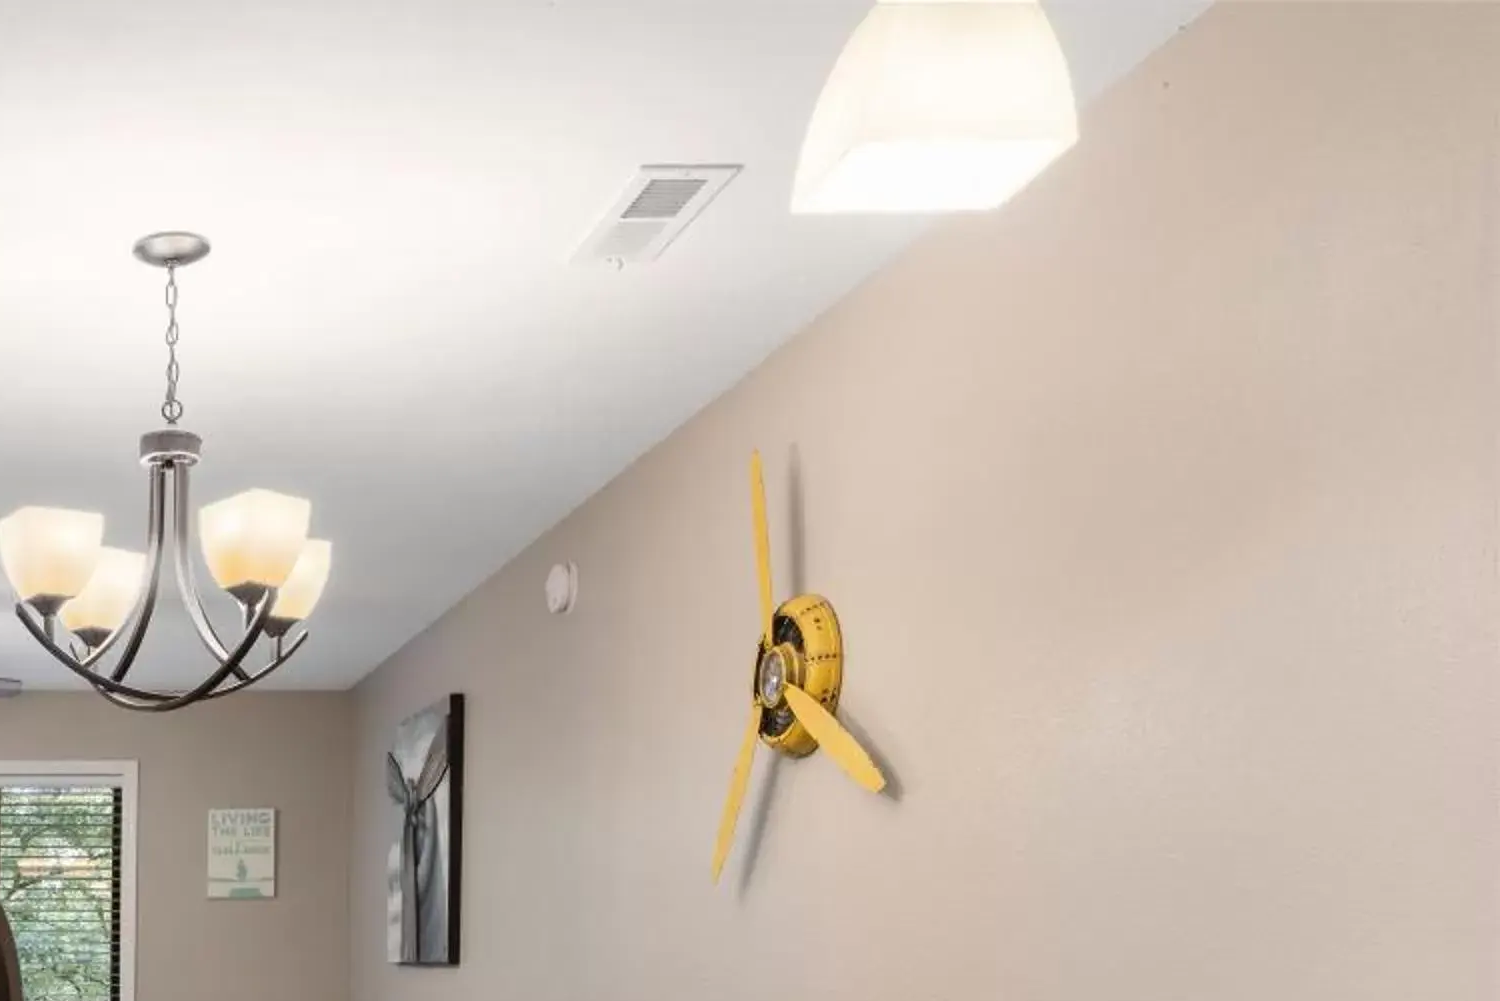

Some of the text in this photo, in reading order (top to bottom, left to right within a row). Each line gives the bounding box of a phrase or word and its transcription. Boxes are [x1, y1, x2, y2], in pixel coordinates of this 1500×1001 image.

[211, 811, 271, 826] LIVING
[211, 826, 271, 837] THE LIFE
